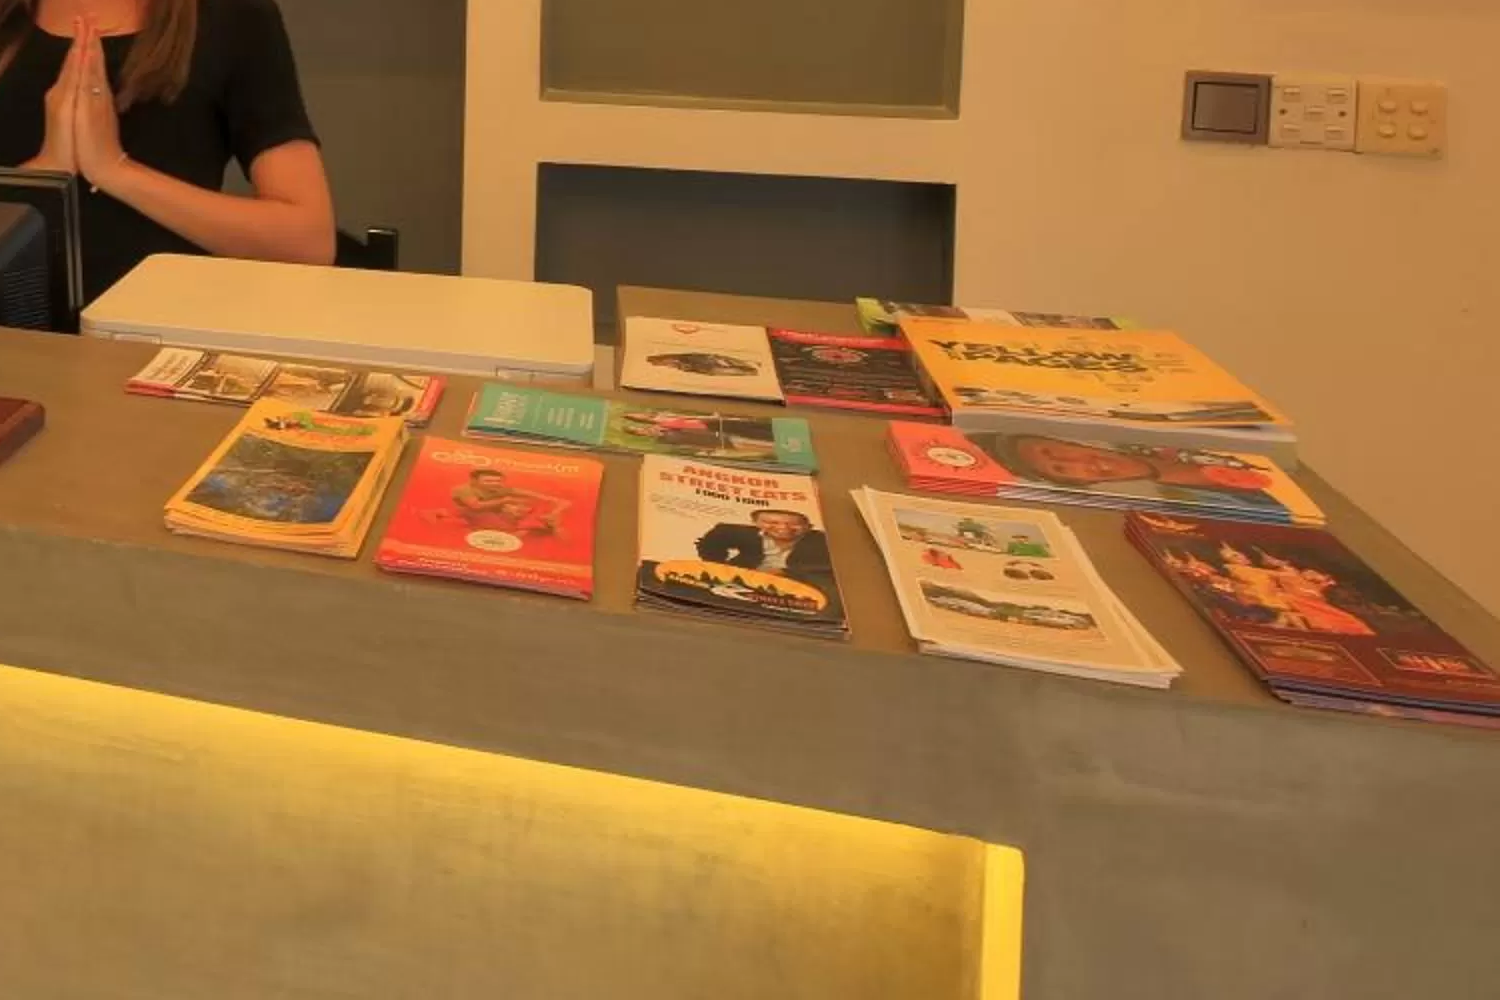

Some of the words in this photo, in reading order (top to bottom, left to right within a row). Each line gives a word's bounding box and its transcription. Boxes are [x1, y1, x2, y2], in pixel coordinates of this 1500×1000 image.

[927, 339, 1133, 361] YELLOW
[659, 471, 743, 496] STREET
[682, 465, 780, 489] ANGKOR
